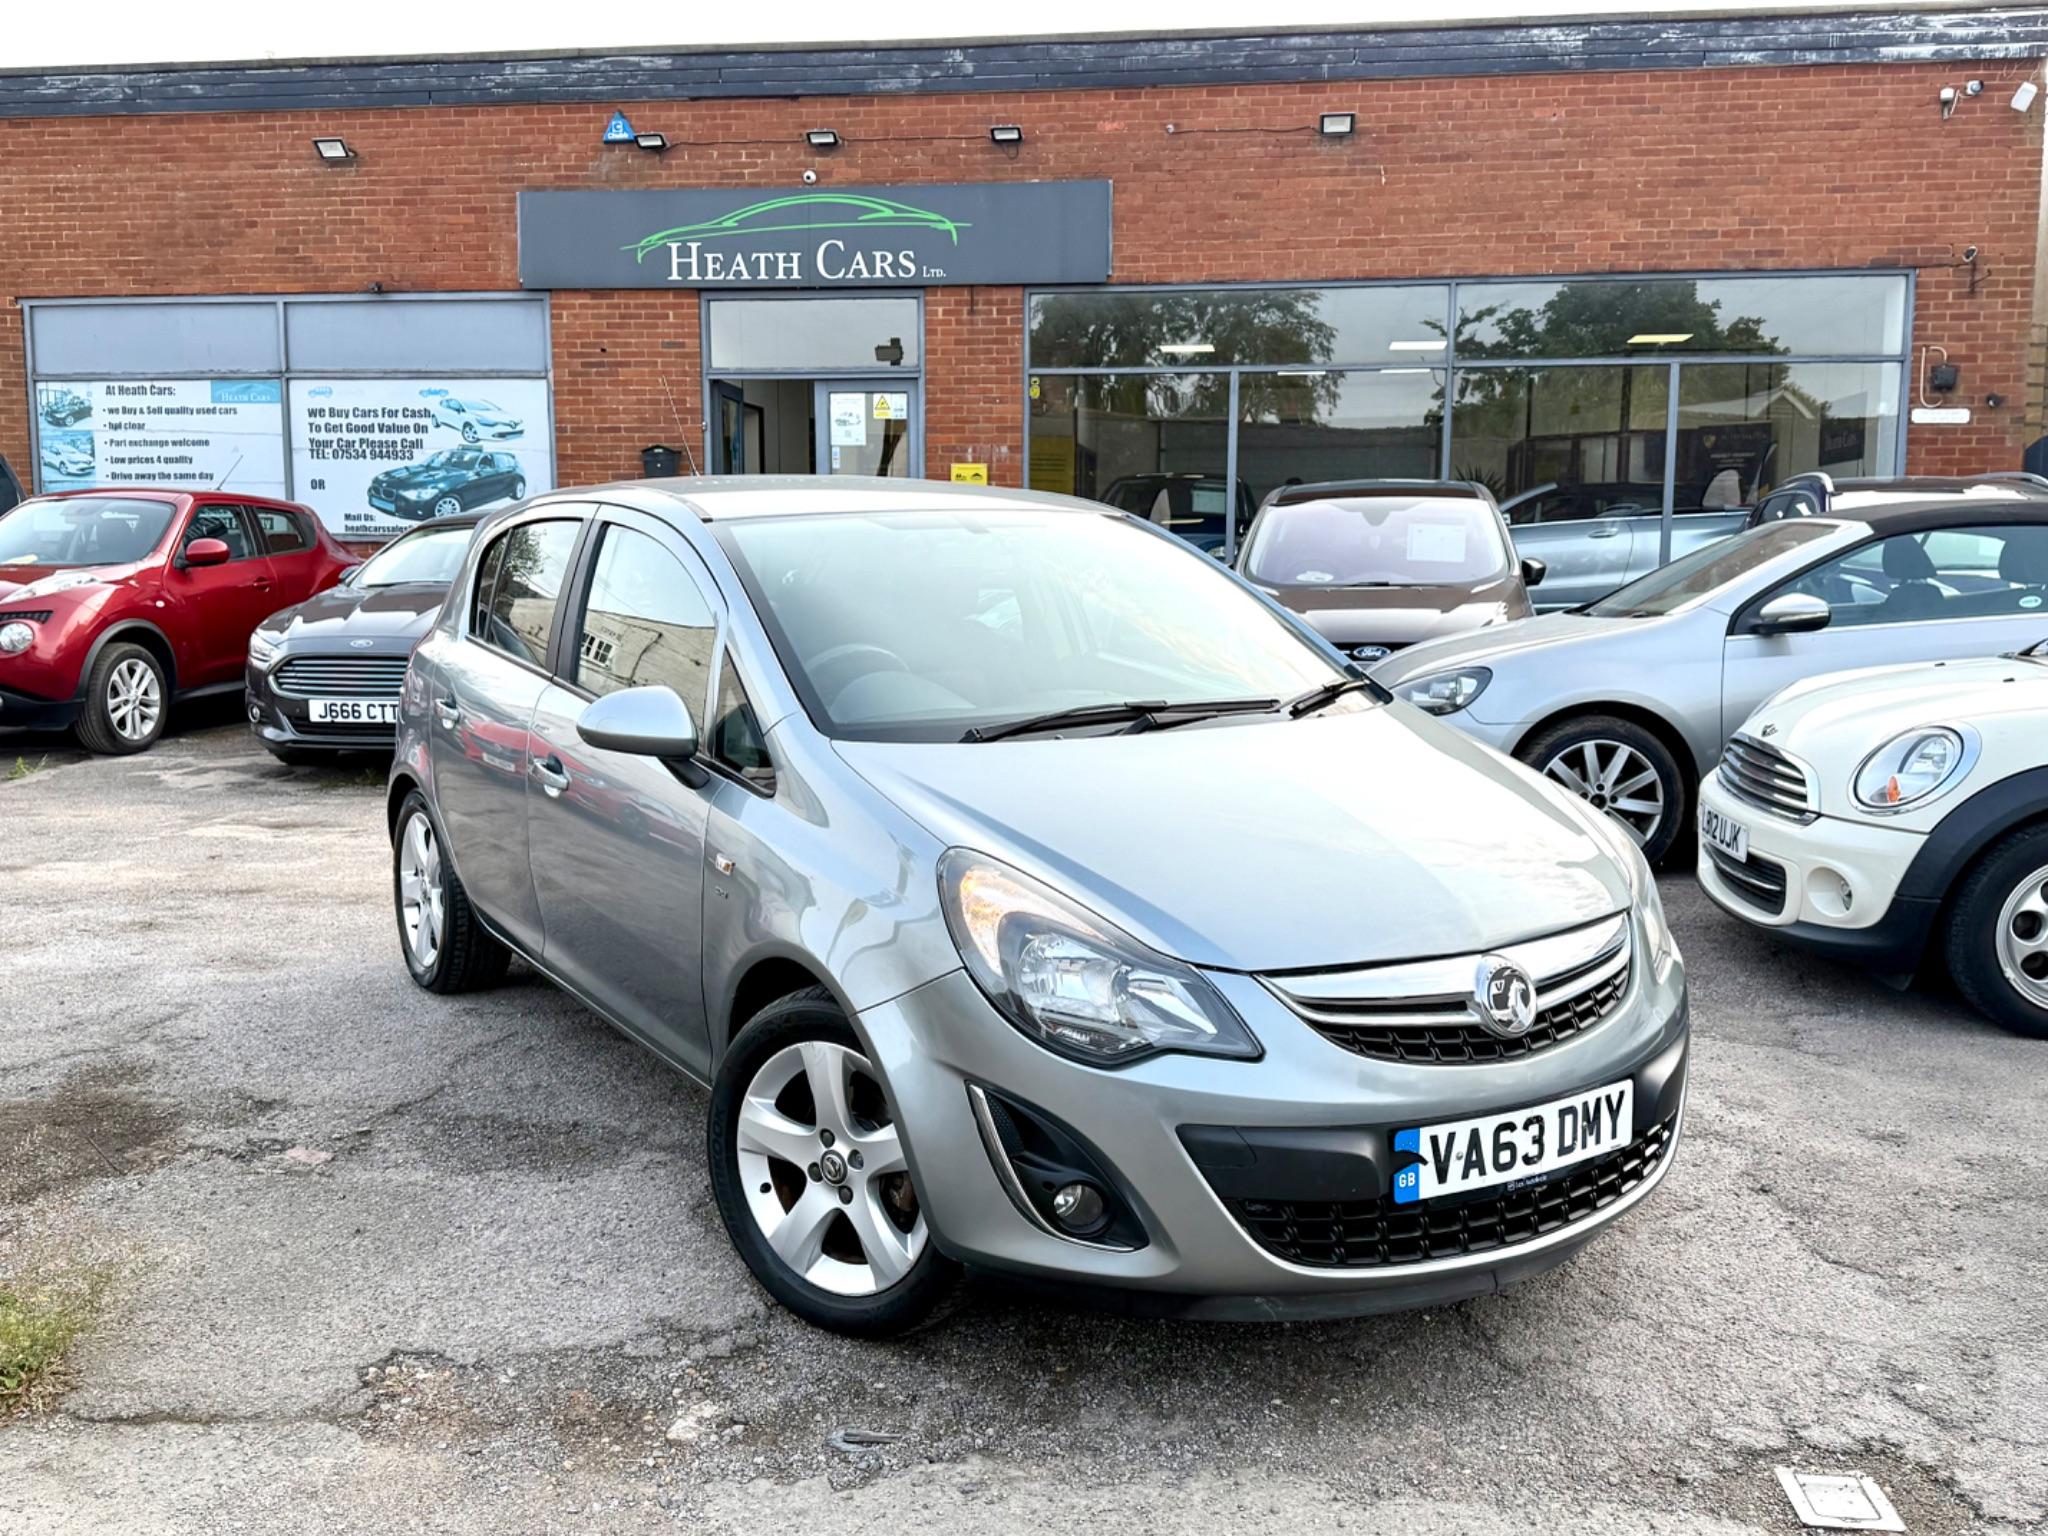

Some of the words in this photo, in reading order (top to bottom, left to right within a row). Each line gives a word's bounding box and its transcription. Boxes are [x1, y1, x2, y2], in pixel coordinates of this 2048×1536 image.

[667, 241, 801, 281] HEATH
[815, 240, 917, 281] CARS
[105, 385, 116, 396] At
[118, 385, 147, 396] Heath
[149, 384, 176, 396] Cars:
[121, 406, 137, 416] Buy
[146, 406, 163, 415] Sell
[164, 406, 194, 416] quality
[196, 406, 217, 415] used
[218, 407, 238, 415] cars
[329, 407, 350, 419] Buy
[352, 407, 379, 418] Cars
[381, 407, 399, 418] For
[402, 407, 431, 418] Cash
[123, 422, 146, 430] clear
[308, 422, 322, 433] To
[324, 422, 343, 433] Get
[345, 422, 375, 433] Good
[377, 422, 411, 433] Value
[413, 423, 428, 434] On
[109, 438, 126, 447] Part
[128, 438, 170, 448] exchange
[171, 438, 210, 447] welcome
[308, 437, 334, 449] Your
[336, 437, 357, 449] Car
[359, 438, 398, 449] Please
[400, 438, 424, 449] Call
[110, 456, 126, 464] Low
[127, 456, 155, 465] prices
[163, 456, 193, 465] quality
[309, 449, 330, 460] TEL:
[332, 449, 367, 460] 07534
[369, 449, 414, 460] 944933
[111, 472, 134, 480] Drive
[134, 472, 156, 481] away
[157, 472, 171, 480] the
[173, 472, 197, 480] same
[198, 472, 214, 481] day
[310, 478, 325, 490] OR
[344, 513, 362, 521] Mail
[318, 703, 361, 720] J666
[1430, 1114, 1545, 1185] VA63
[1556, 1089, 1626, 1158] DMY
[1399, 1171, 1416, 1188] GB
